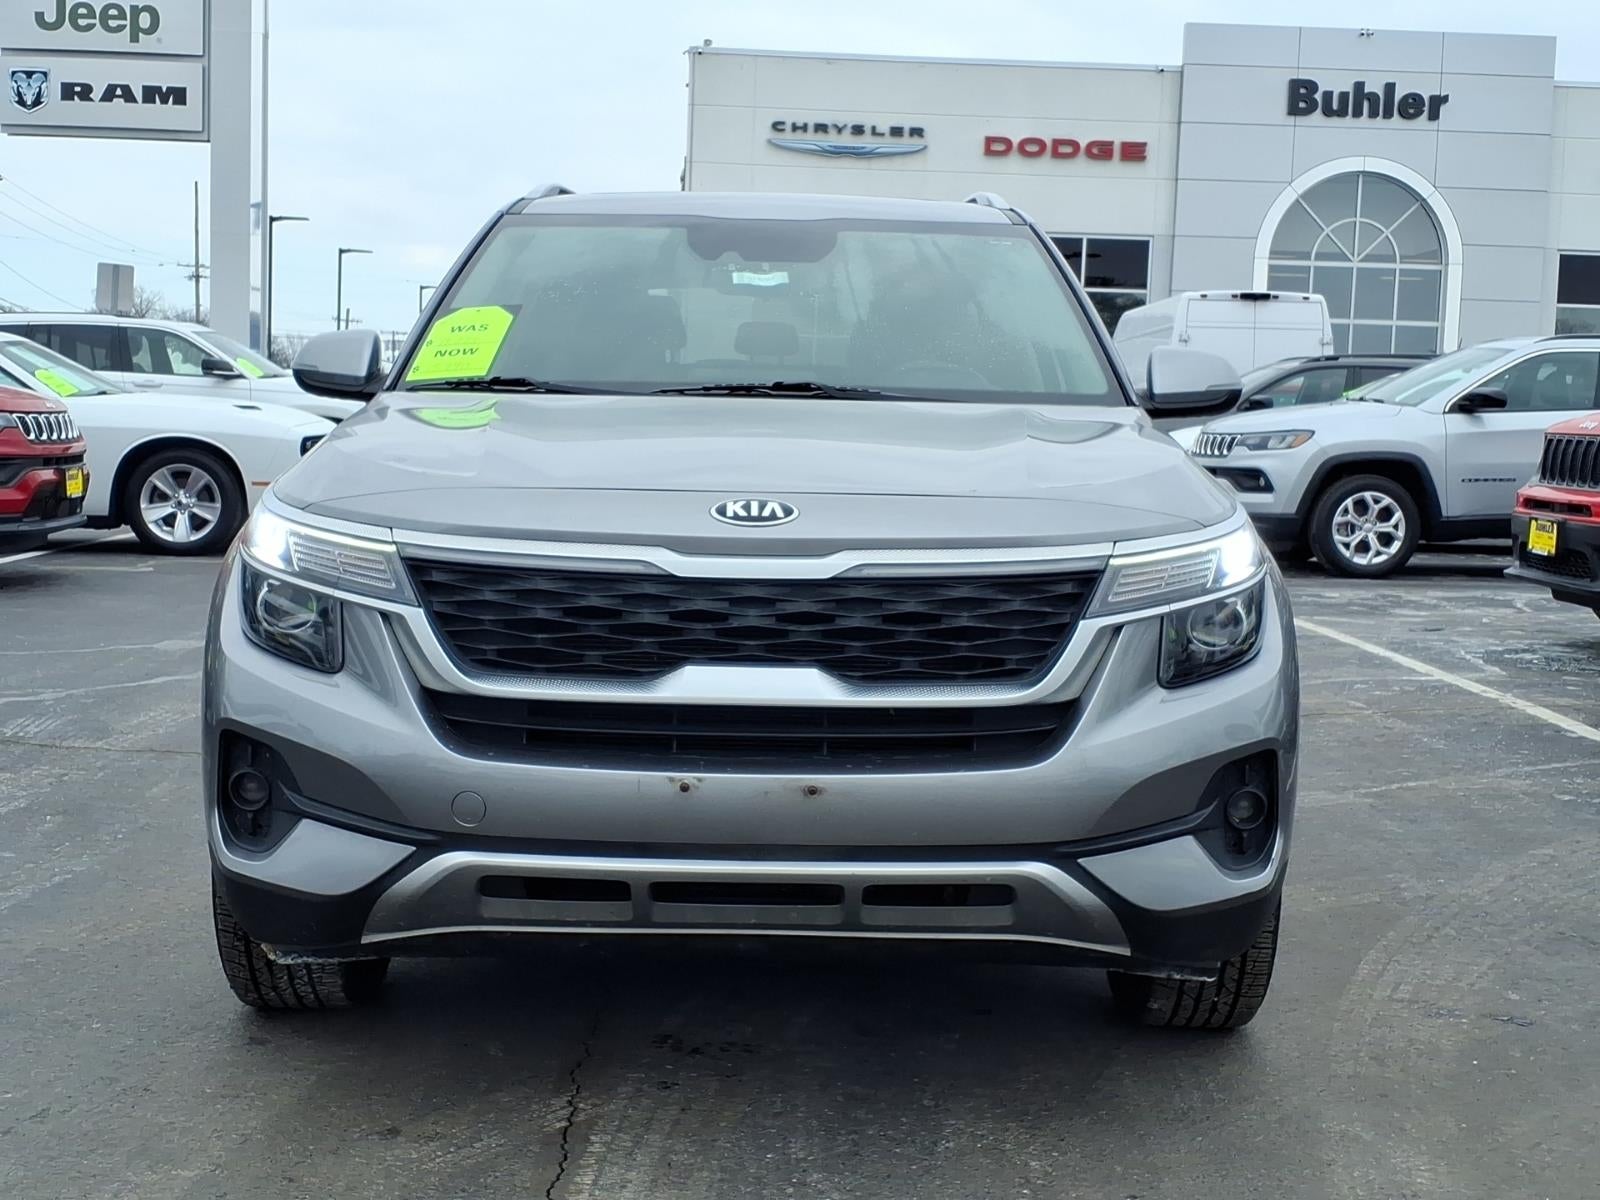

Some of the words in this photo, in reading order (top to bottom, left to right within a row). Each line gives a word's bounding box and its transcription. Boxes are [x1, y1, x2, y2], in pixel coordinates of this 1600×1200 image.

[34, 0, 160, 43] Jeep
[60, 82, 187, 106] RAM
[1287, 78, 1449, 121] Buhler
[771, 121, 925, 138] CHRYSLER
[984, 136, 1148, 161] DODGE
[450, 323, 489, 333] WAS
[434, 347, 479, 358] NOW
[726, 500, 784, 518] KIA
